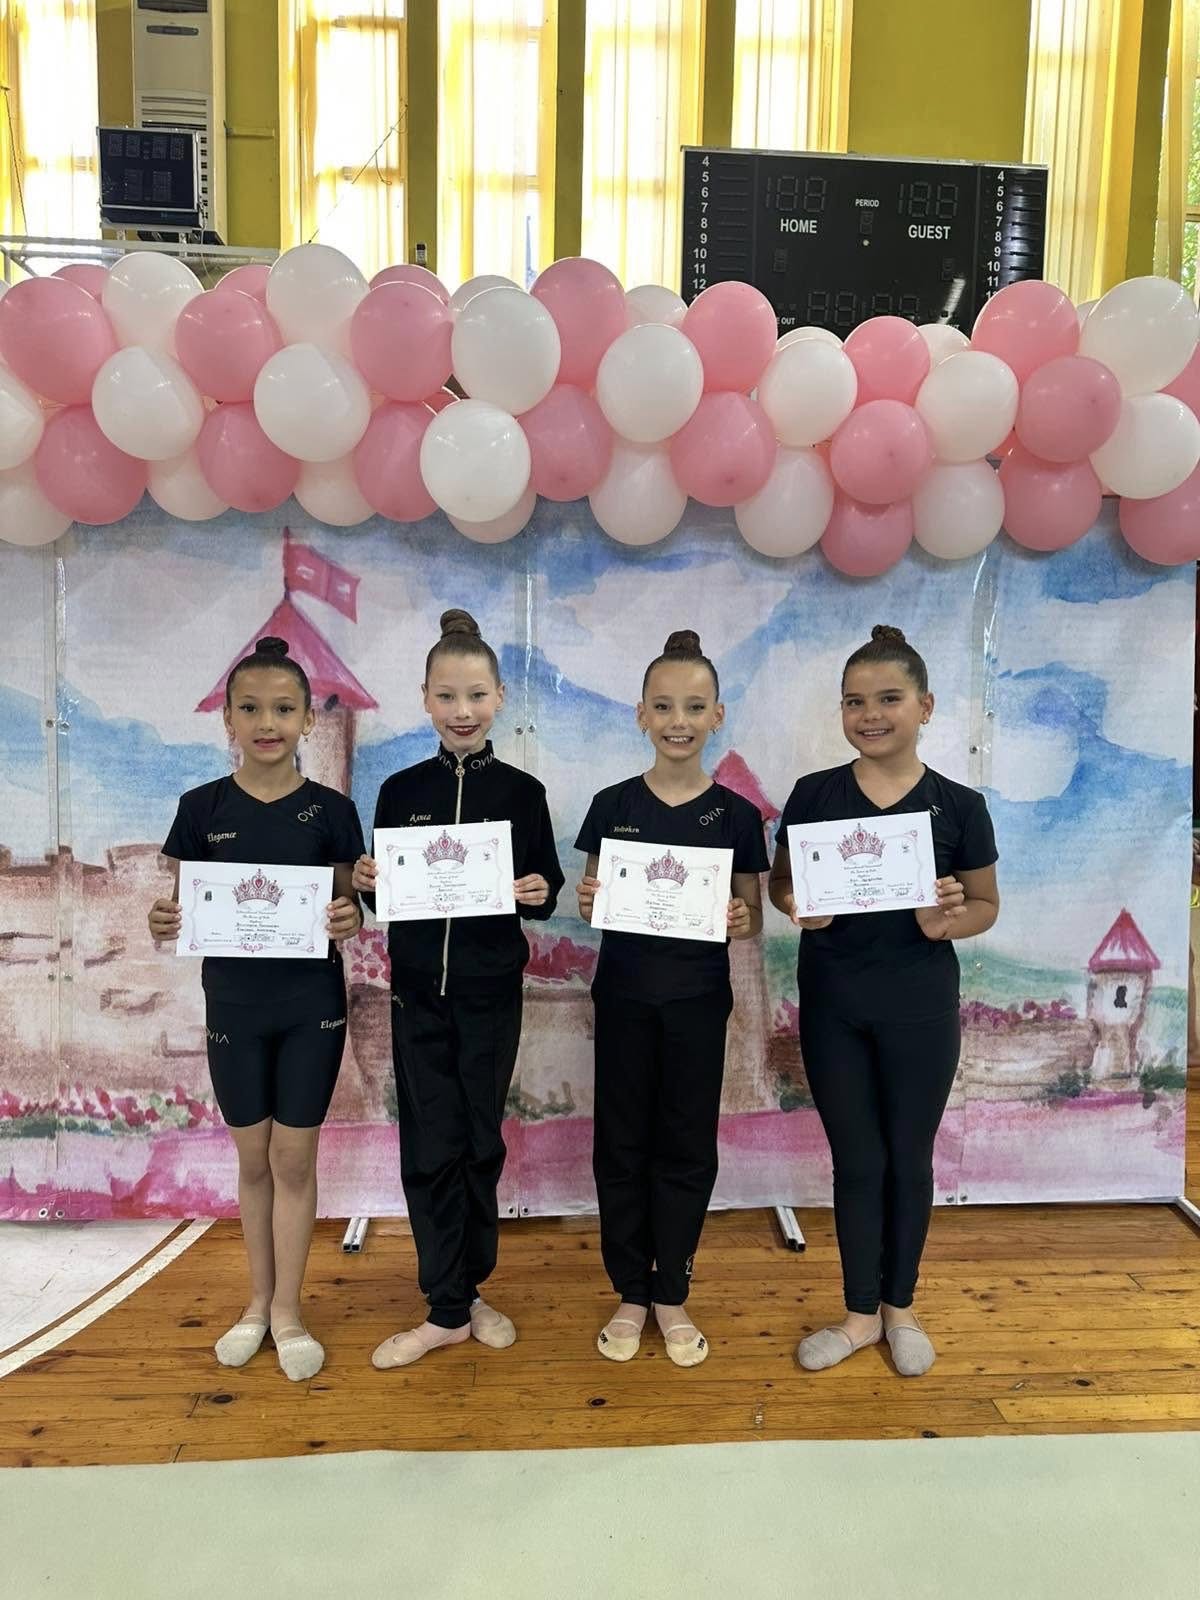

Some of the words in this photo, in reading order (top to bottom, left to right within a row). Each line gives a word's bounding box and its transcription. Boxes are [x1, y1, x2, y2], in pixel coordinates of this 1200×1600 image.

[702, 156, 710, 166] 4
[702, 171, 709, 182] 5
[997, 171, 1005, 182] 4
[701, 187, 709, 198] 6
[997, 186, 1004, 197] 5
[701, 202, 709, 213] 7
[855, 198, 880, 207] PERIOD
[996, 201, 1004, 212] 6
[700, 217, 708, 229] 8
[780, 218, 818, 234] HOME
[996, 216, 1003, 227] 7
[908, 224, 951, 240] GUEST
[995, 231, 1002, 242] 8
[700, 233, 708, 244] 9
[693, 248, 707, 259] 10
[994, 246, 1001, 257] 9
[693, 263, 706, 274] 11
[987, 261, 1001, 272] 10
[692, 279, 707, 290] 12
[987, 276, 999, 287] 11
[780, 316, 796, 326] OUT
